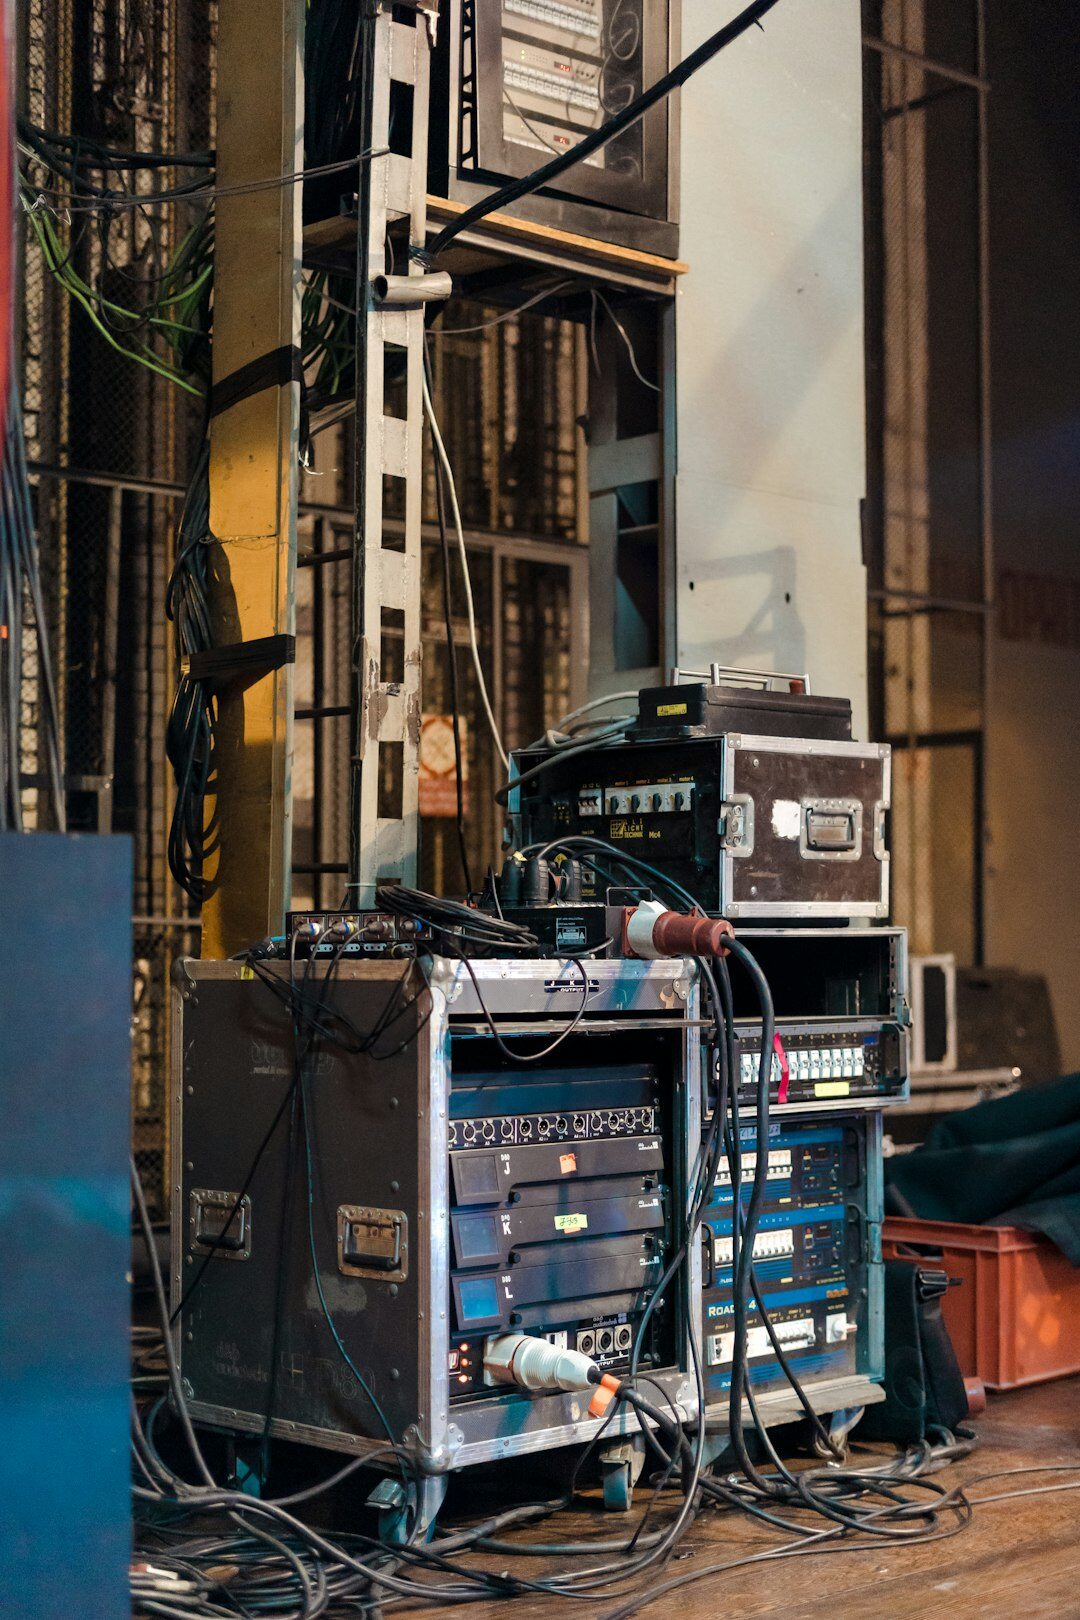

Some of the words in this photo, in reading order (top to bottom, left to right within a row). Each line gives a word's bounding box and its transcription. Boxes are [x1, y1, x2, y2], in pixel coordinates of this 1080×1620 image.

[504, 1162, 511, 1175] J
[503, 1222, 512, 1235] K
[504, 1286, 513, 1299] L
[748, 1299, 757, 1310] 4
